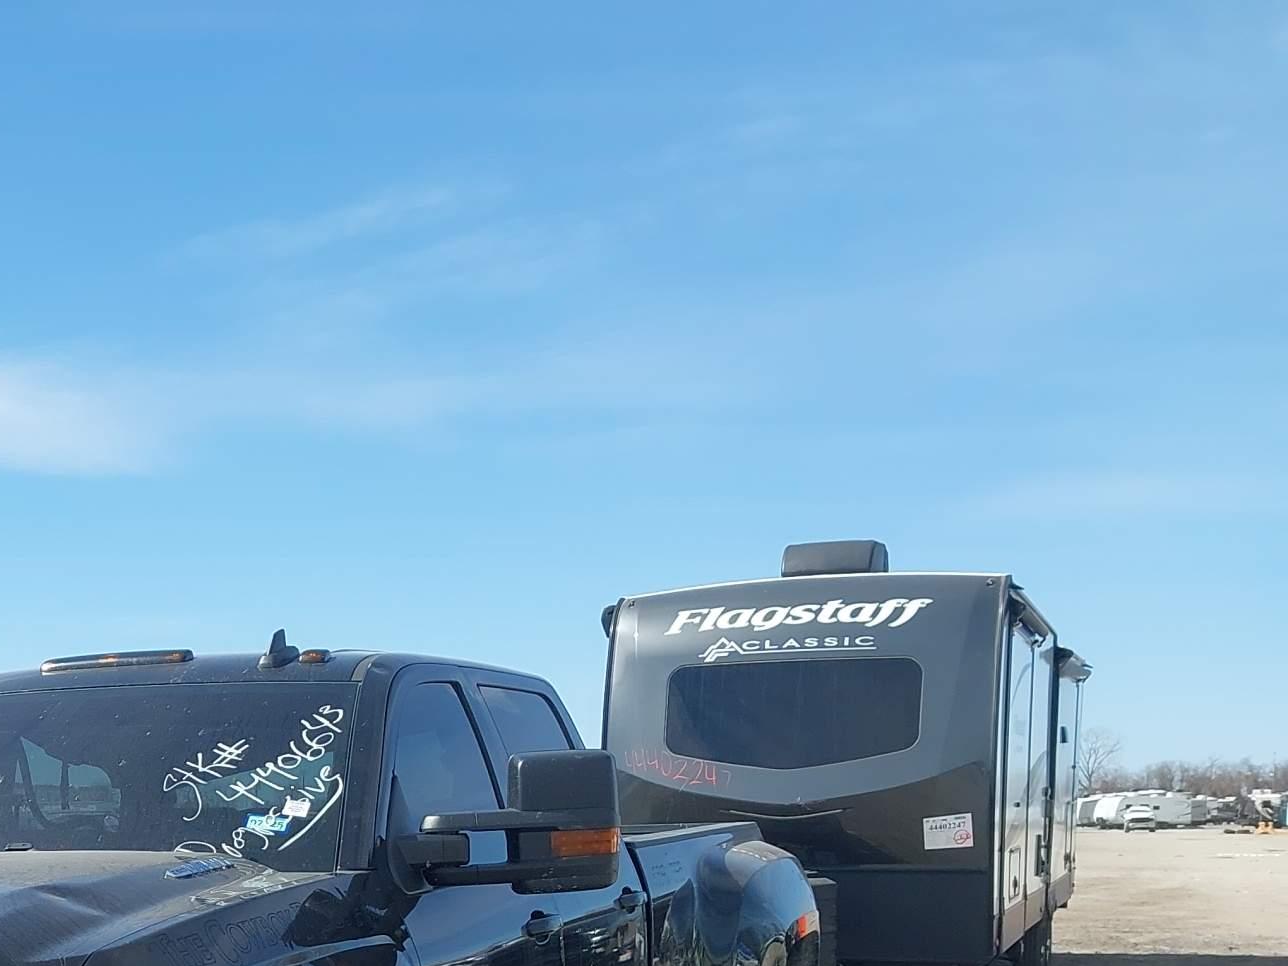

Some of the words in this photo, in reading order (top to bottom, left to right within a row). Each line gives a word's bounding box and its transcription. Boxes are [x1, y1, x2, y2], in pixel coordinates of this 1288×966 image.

[663, 598, 933, 635] Flagstaff
[741, 635, 875, 650] CLASSIC
[215, 704, 344, 805] 44406643
